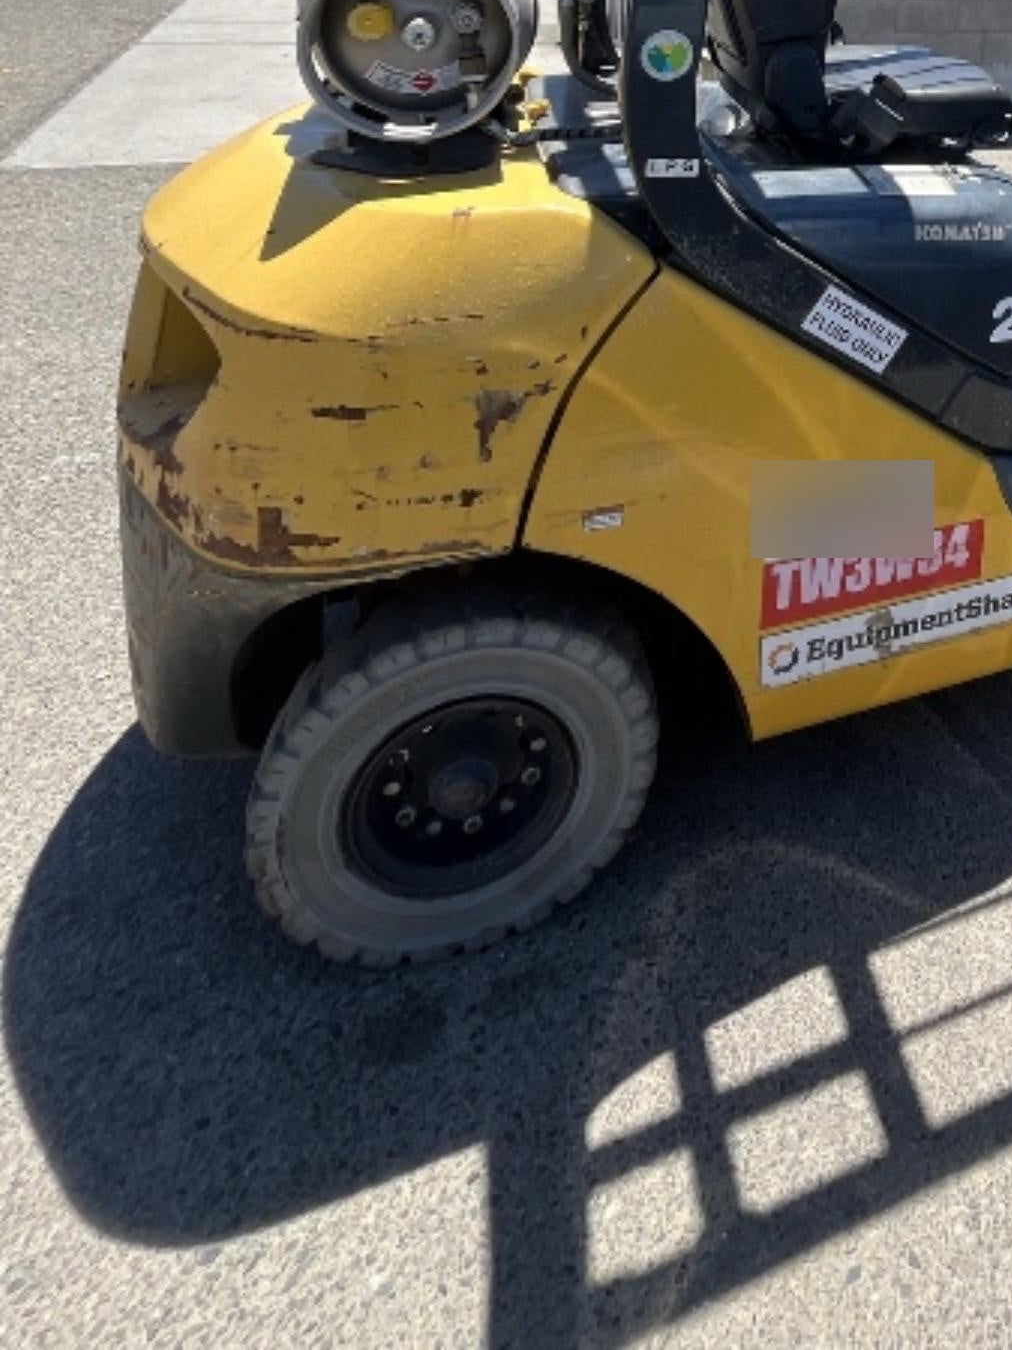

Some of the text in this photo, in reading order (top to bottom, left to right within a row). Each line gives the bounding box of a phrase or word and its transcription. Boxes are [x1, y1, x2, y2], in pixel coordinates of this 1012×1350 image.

[914, 220, 1006, 242] KOMATSU
[809, 311, 889, 365] FLUID ONLY
[823, 292, 900, 349] HYDRAULIC
